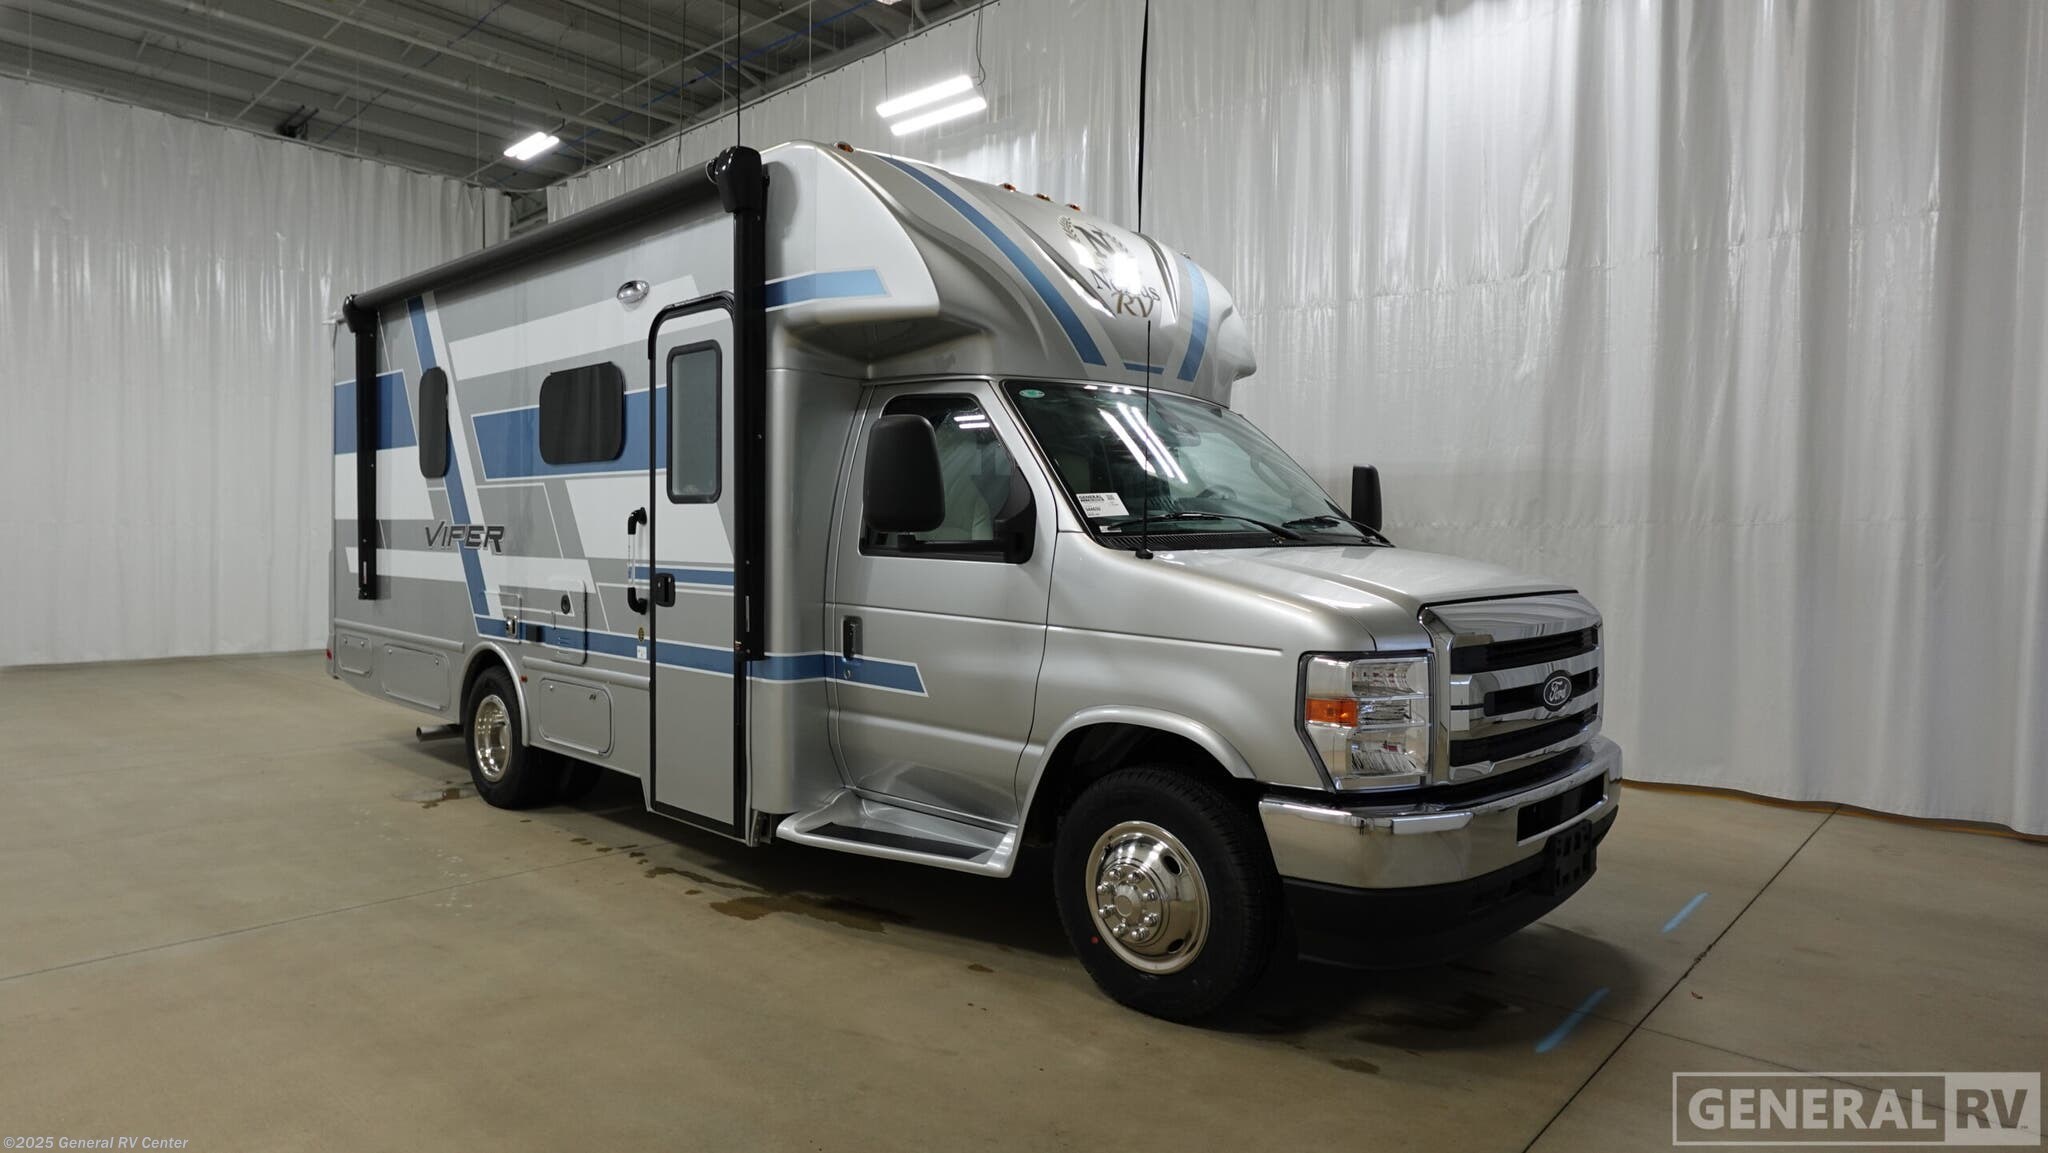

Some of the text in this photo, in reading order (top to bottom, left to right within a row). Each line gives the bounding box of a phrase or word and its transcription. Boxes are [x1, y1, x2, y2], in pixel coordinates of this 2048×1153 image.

[1111, 290, 1154, 318] RV
[424, 520, 505, 554] VIPER
[1549, 680, 1567, 702] Ford
